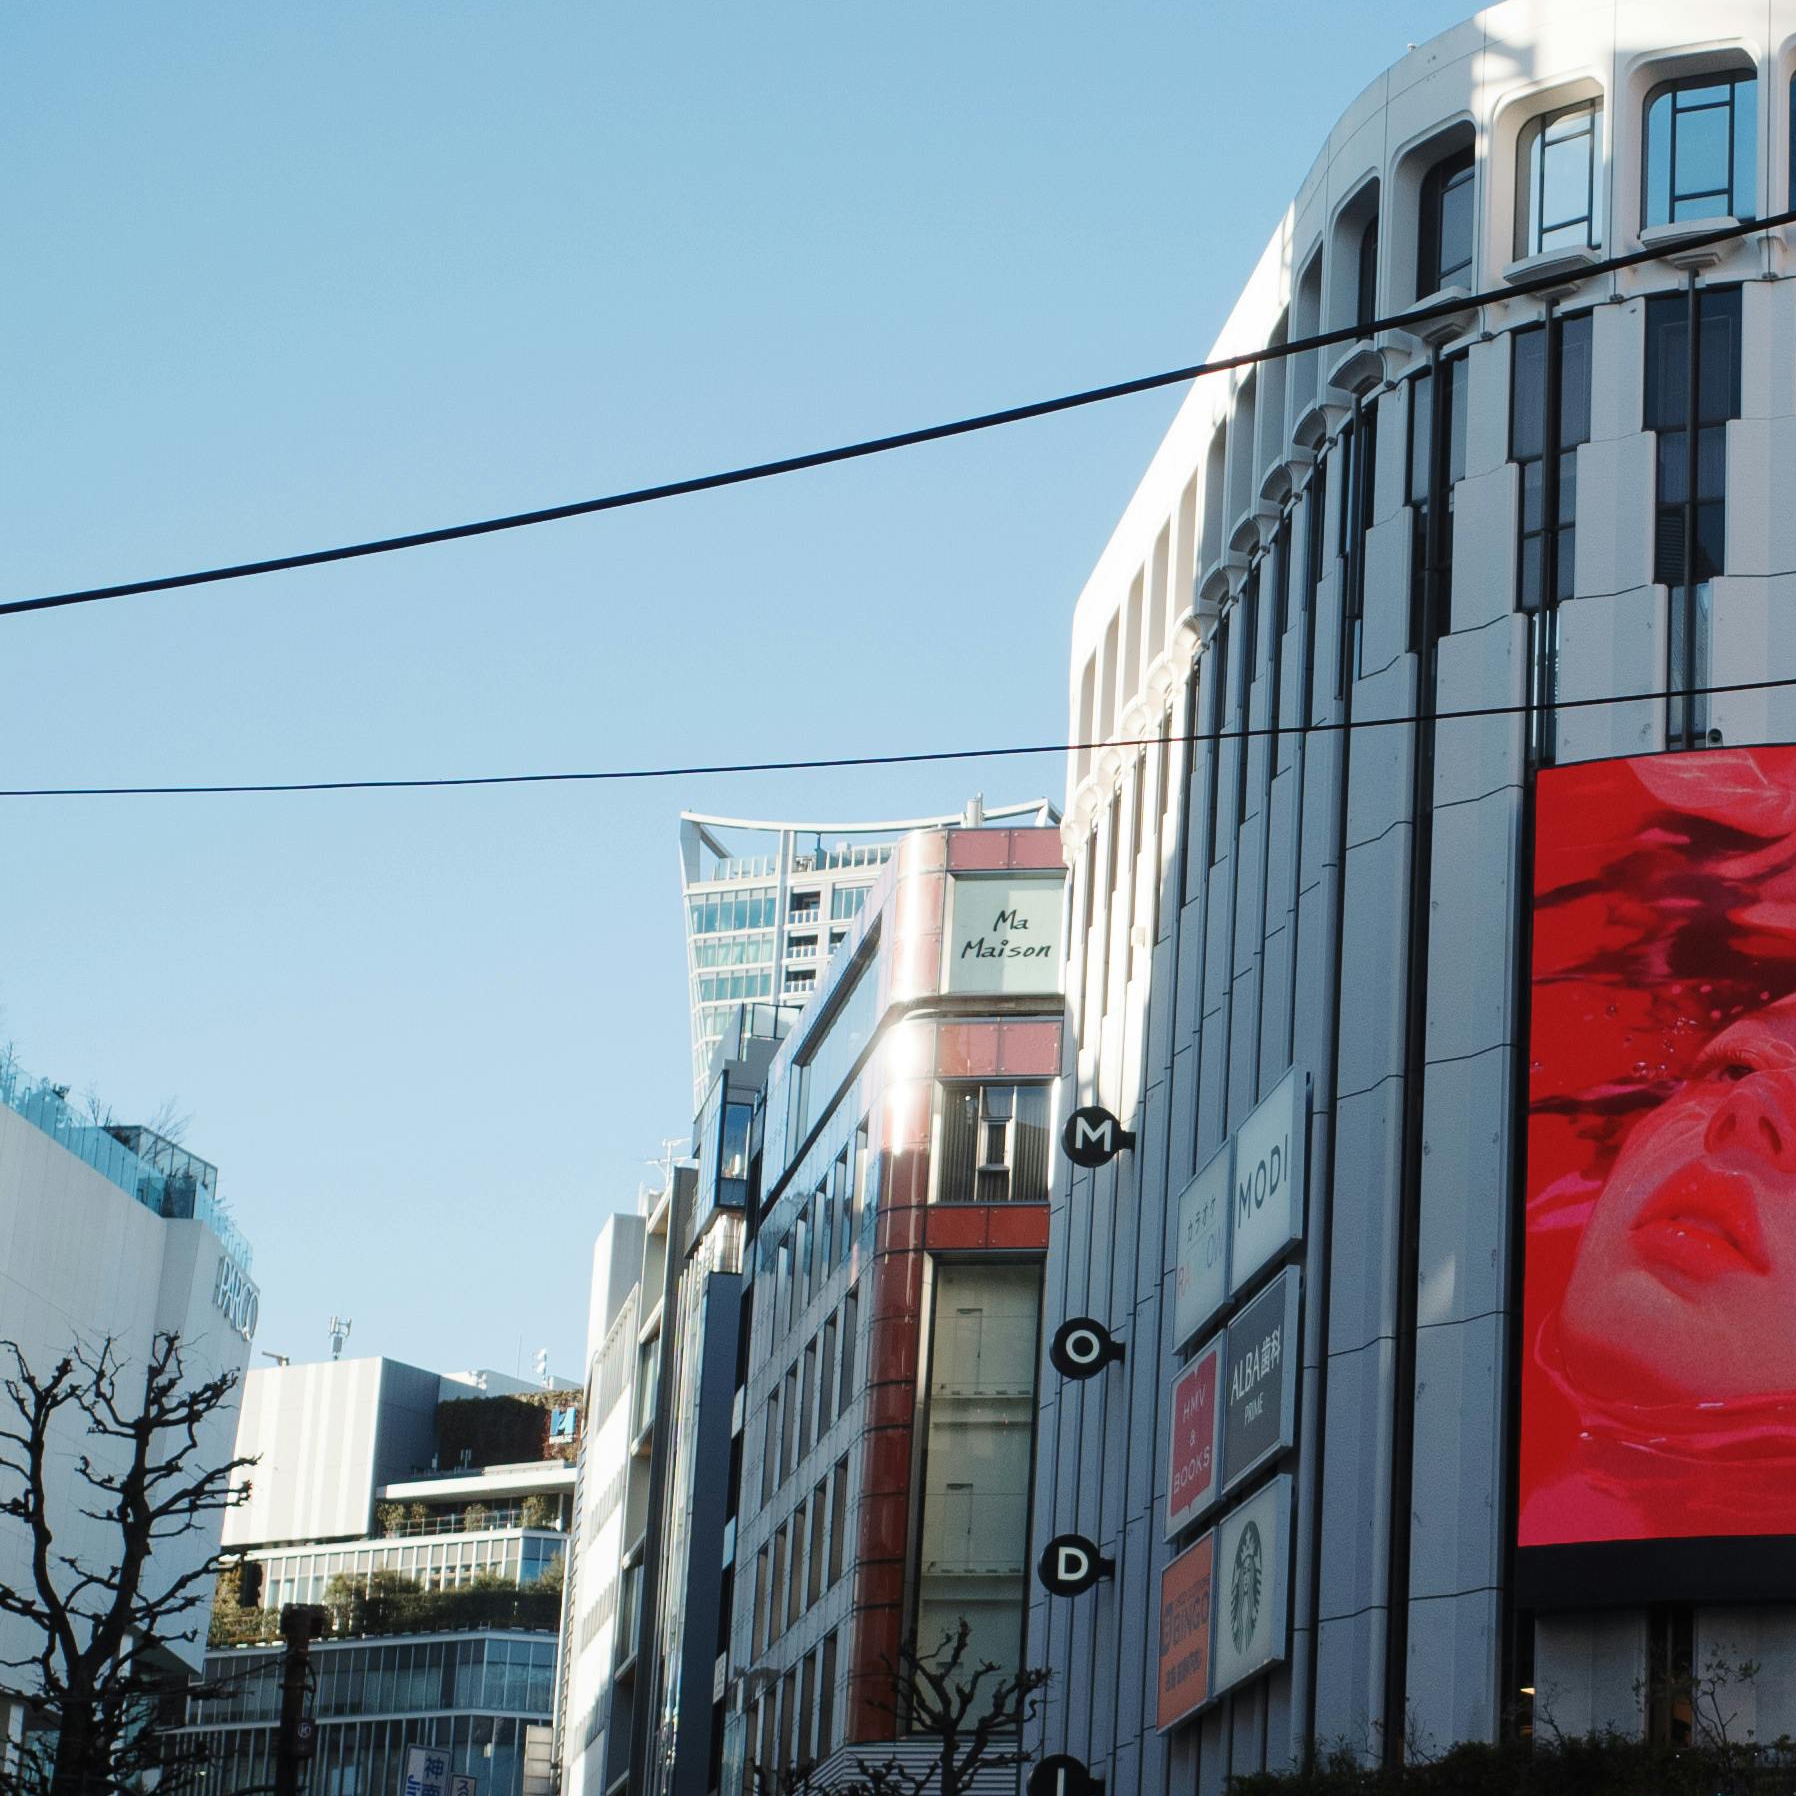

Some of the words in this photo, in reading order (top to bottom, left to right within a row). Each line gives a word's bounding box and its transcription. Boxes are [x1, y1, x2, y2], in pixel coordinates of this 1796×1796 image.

[993, 909, 1029, 932] Ma
[961, 937, 1051, 959] Maison
[1238, 1134, 1288, 1228] MODI
[1186, 1196, 1217, 1244] カラオケ
[213, 1256, 259, 1341] PARCO
[1182, 1383, 1207, 1424] HMV
[1244, 1391, 1265, 1429] PRIME
[1189, 1428, 1197, 1446] &
[1173, 1445, 1211, 1495] BOOKS
